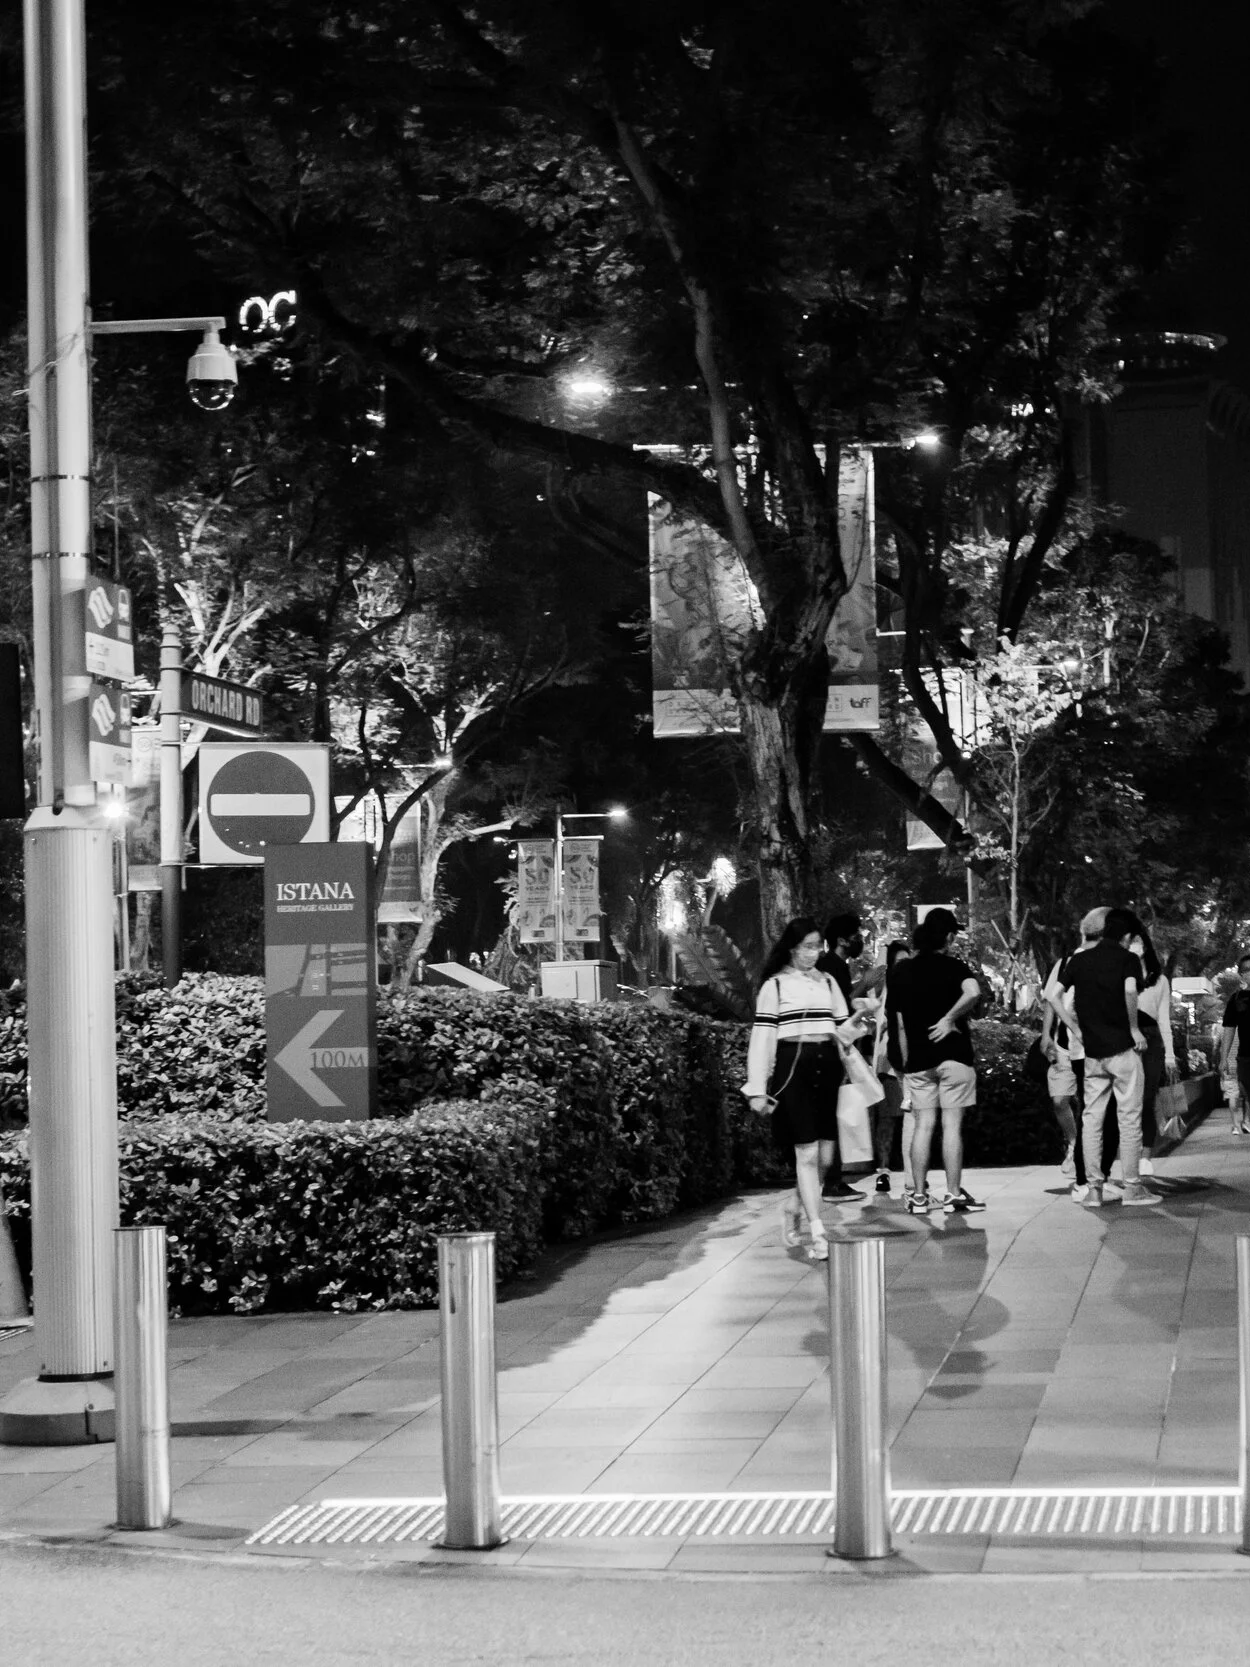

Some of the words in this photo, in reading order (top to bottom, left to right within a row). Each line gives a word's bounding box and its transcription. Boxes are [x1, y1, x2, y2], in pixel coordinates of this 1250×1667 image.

[191, 679, 243, 722] ORCHARD
[245, 695, 260, 726] RD
[912, 749, 943, 765] Sho
[276, 882, 355, 901] ISTANA
[276, 904, 317, 913] HERITAGE
[318, 903, 354, 912] GALLERY
[311, 1050, 365, 1068] 100M
